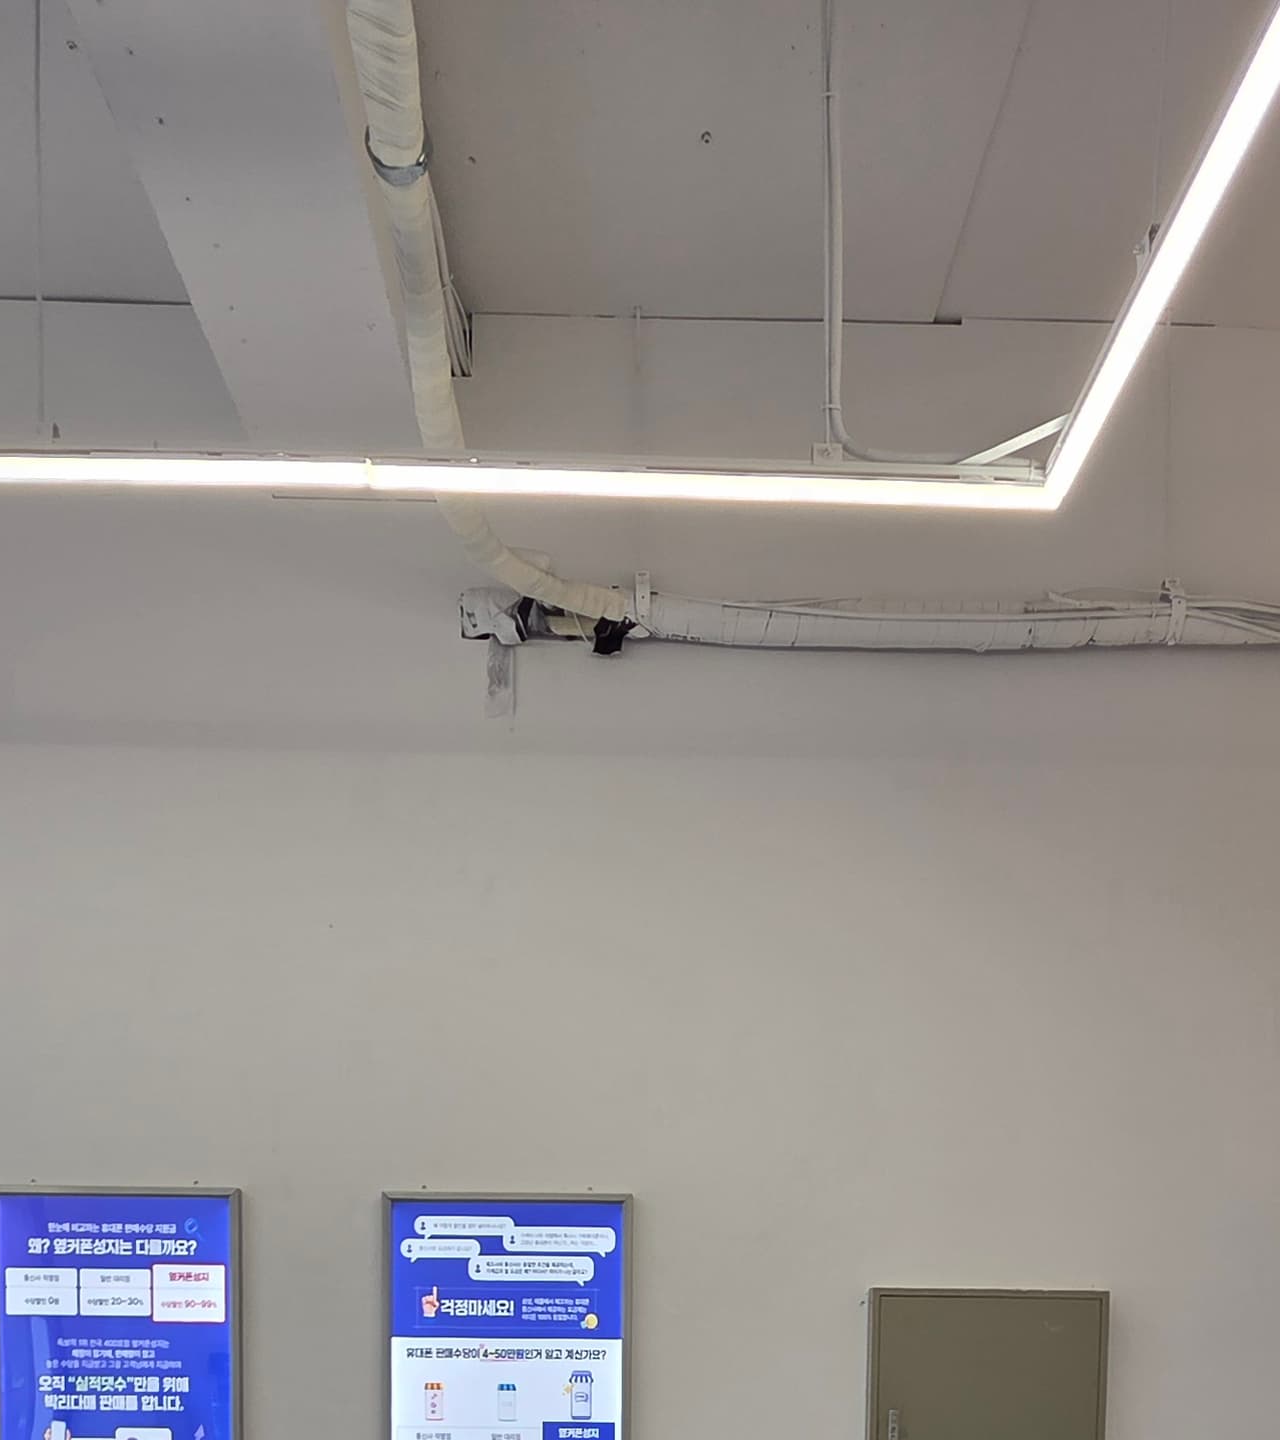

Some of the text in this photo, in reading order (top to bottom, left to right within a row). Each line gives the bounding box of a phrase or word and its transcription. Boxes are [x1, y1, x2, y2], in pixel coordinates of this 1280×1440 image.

[28, 1239, 197, 1255] 왜? 옆커폰성지는 다를까요?
[169, 1272, 209, 1282] 옆커폰성지
[441, 1299, 514, 1316] 걱정마세요!
[565, 1349, 606, 1360] 계신가요?
[39, 1376, 65, 1391] 오직
[163, 1377, 189, 1392] 위해
[44, 1395, 184, 1411] 박리다매 판매를 합니다.
[558, 1428, 599, 1439] 옆커폰성지
